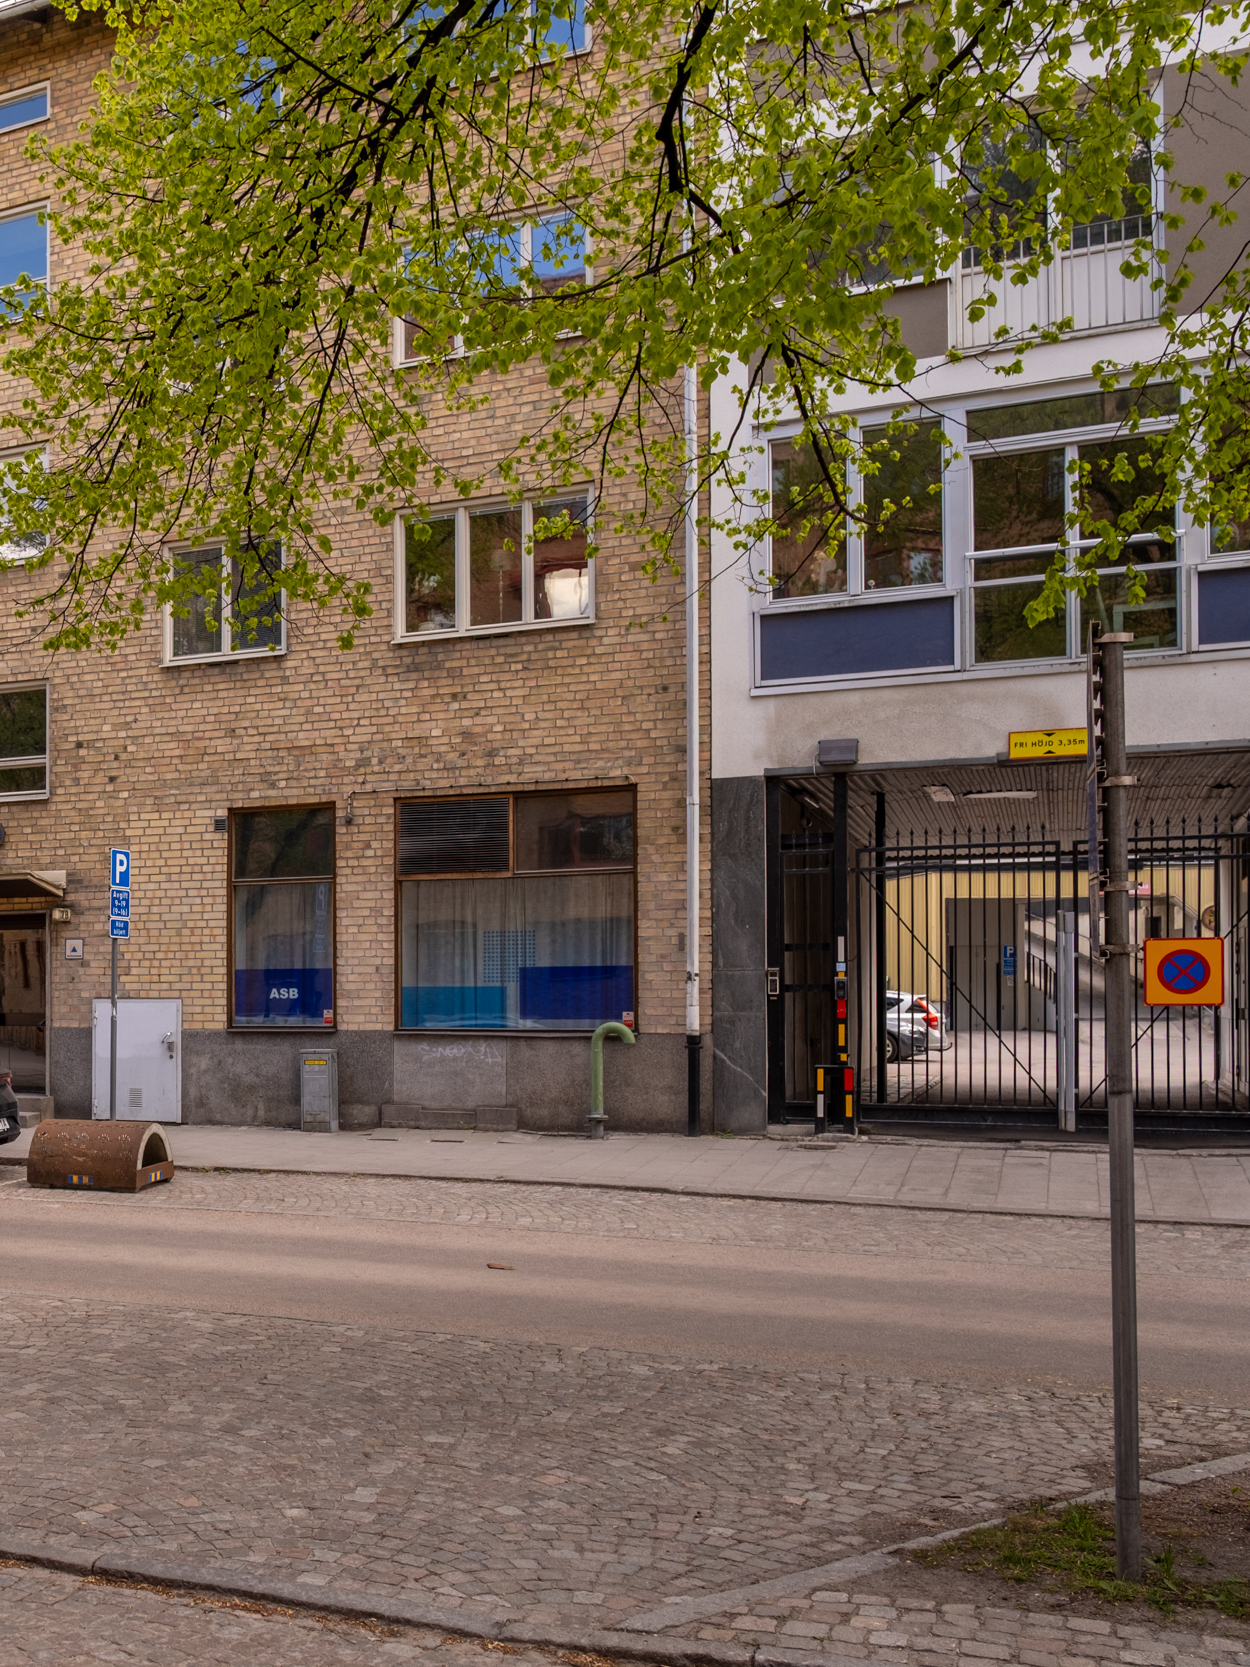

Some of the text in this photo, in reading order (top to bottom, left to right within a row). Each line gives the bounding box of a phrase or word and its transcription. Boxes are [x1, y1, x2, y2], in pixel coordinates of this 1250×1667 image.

[1031, 739, 1054, 747] HÖJD
[1057, 738, 1085, 747] 3,35m
[115, 853, 127, 883] P
[112, 890, 128, 900] Avgift
[269, 987, 299, 999] ASB
